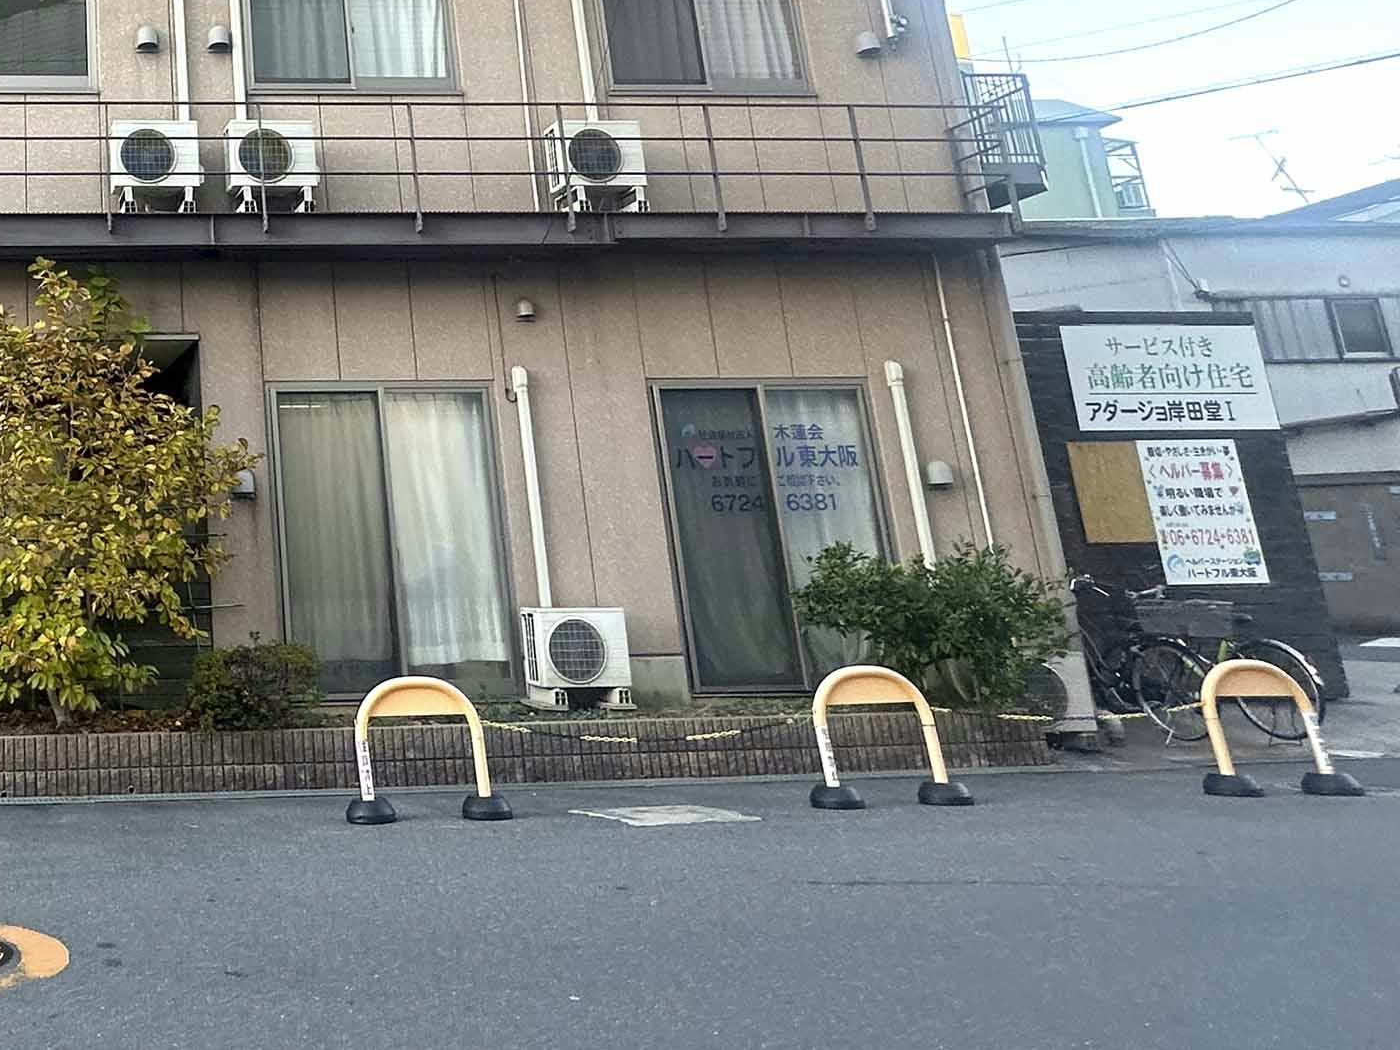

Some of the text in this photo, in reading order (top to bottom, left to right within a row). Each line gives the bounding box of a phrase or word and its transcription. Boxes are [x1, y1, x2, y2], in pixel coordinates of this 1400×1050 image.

[1105, 336, 1213, 358] サービス付き
[1087, 362, 1255, 390] 高齢者向け住宅
[773, 423, 824, 441] 木蓮会
[712, 493, 837, 512] 6724 6381
[1188, 567, 1259, 579] ハートフル東大阪
